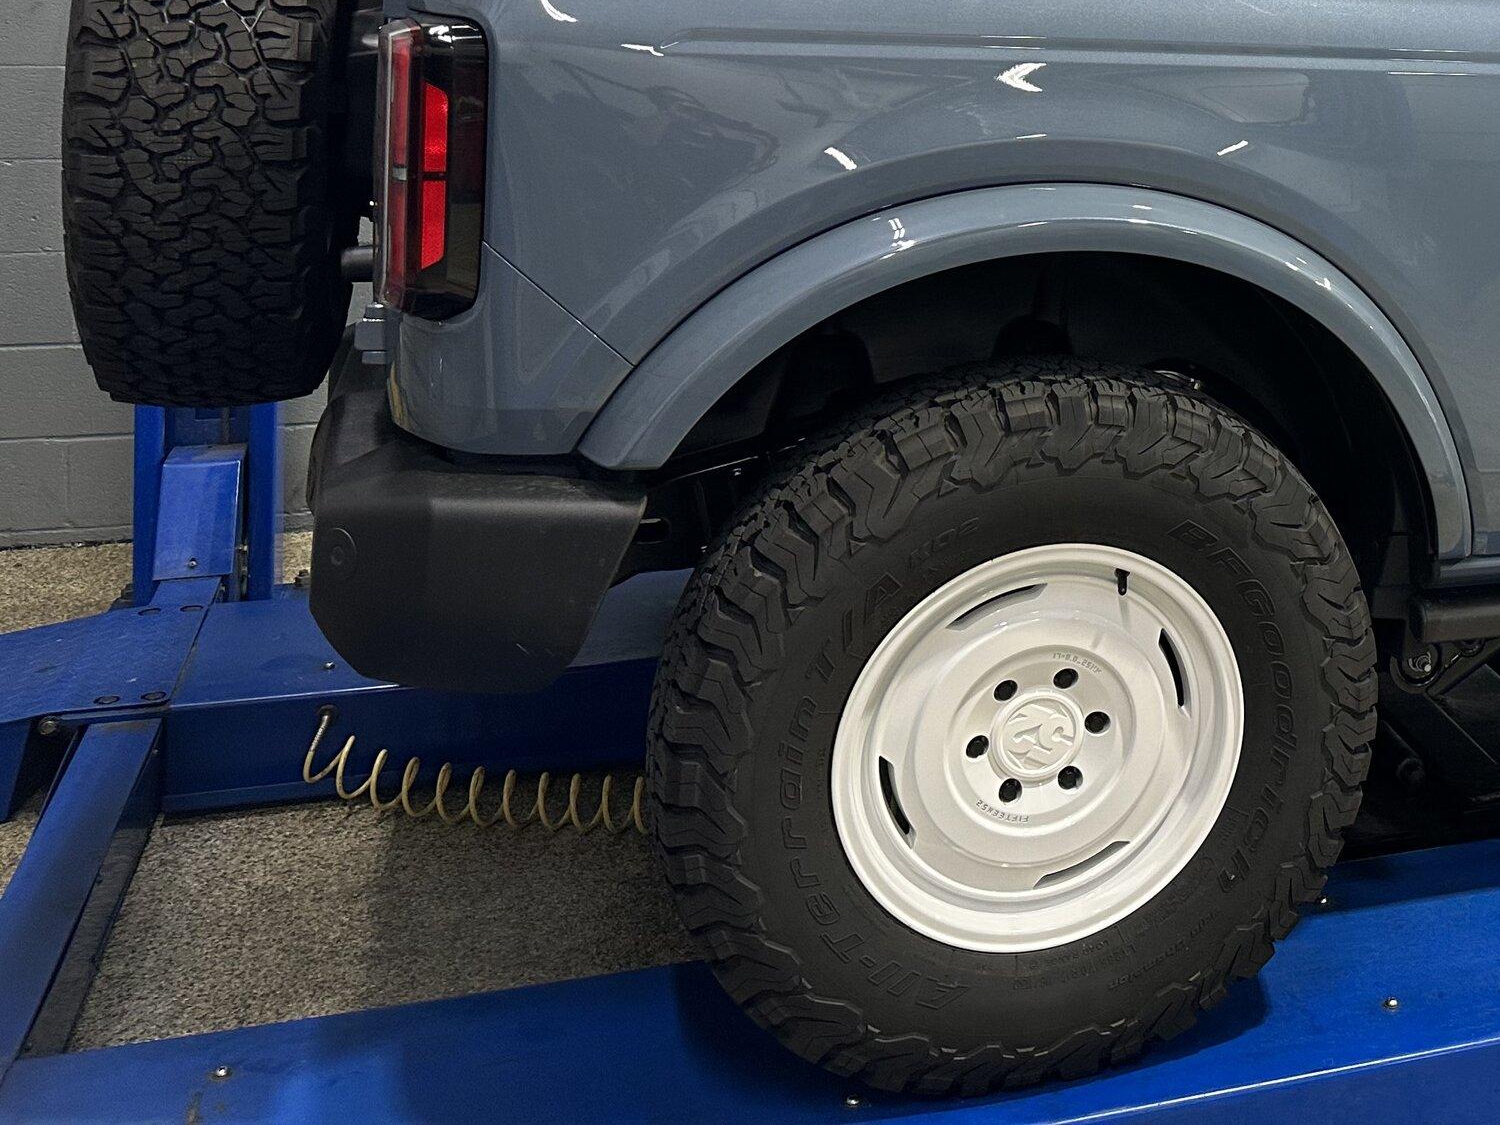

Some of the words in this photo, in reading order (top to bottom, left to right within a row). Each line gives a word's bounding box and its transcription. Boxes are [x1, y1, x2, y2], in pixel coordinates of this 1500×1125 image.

[805, 573, 900, 683] T/A
[1168, 519, 1298, 892] BFGoodrich
[778, 695, 968, 1009] All-Terrain
